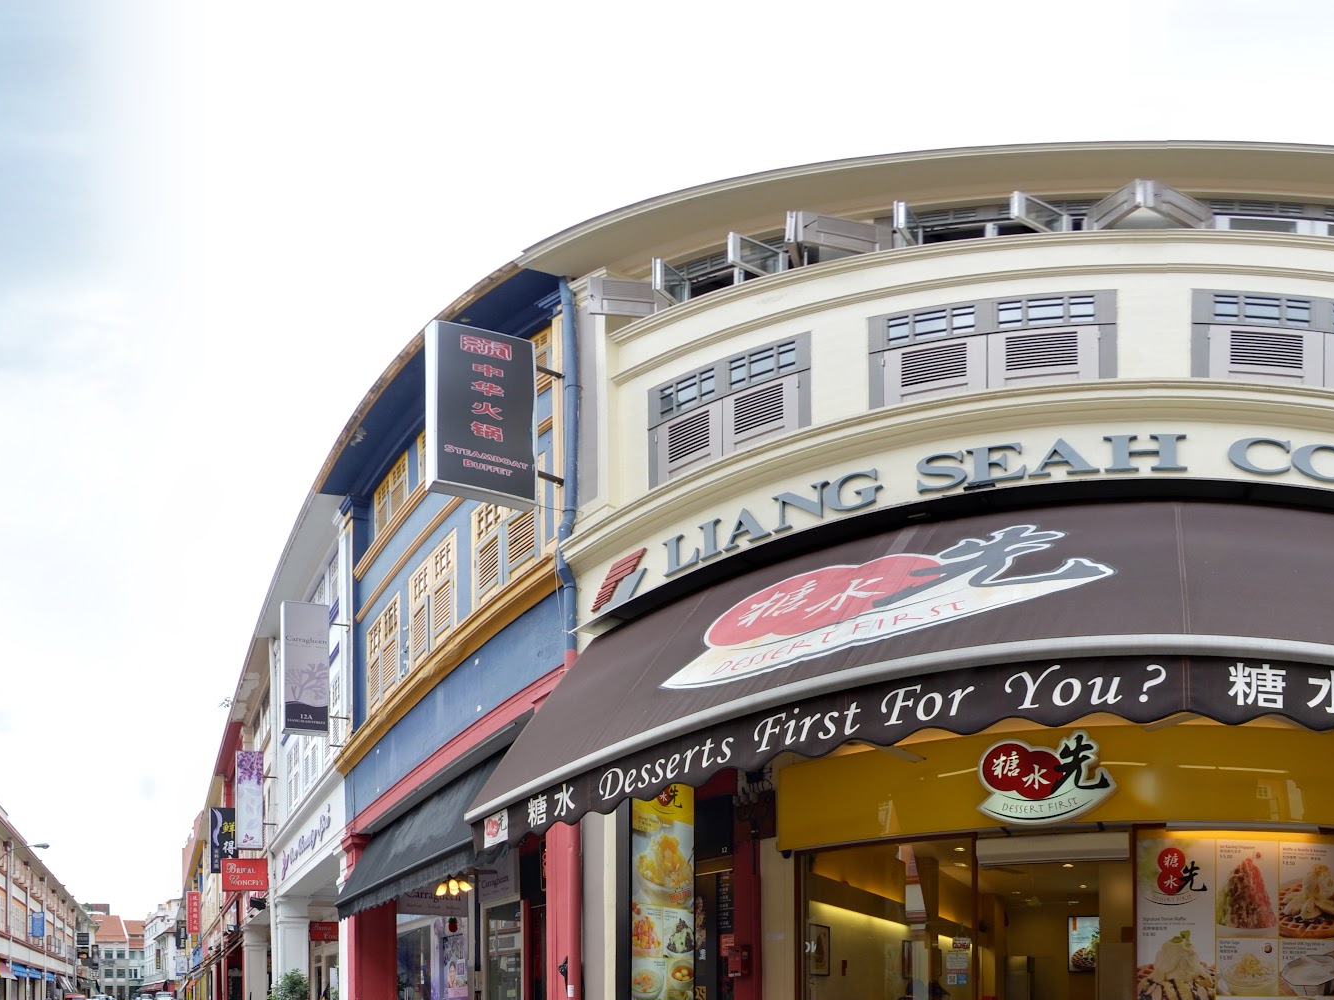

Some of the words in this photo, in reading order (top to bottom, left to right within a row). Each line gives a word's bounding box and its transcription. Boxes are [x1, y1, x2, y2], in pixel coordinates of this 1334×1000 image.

[471, 363, 504, 442] 中华火锅
[444, 443, 528, 470] STEAMBOAT
[463, 458, 513, 476] BUFFET
[662, 468, 884, 578] LIANG
[916, 433, 1188, 494] SEAH
[710, 628, 838, 675] DESSERT
[852, 600, 965, 636] FIRST
[598, 735, 735, 801] Desserts
[754, 702, 861, 753] First
[880, 684, 975, 726] For
[1004, 664, 1166, 711] You?
[528, 783, 575, 828] 糖水
[1001, 803, 1044, 814] DESSERT
[1048, 797, 1077, 811] FIRST
